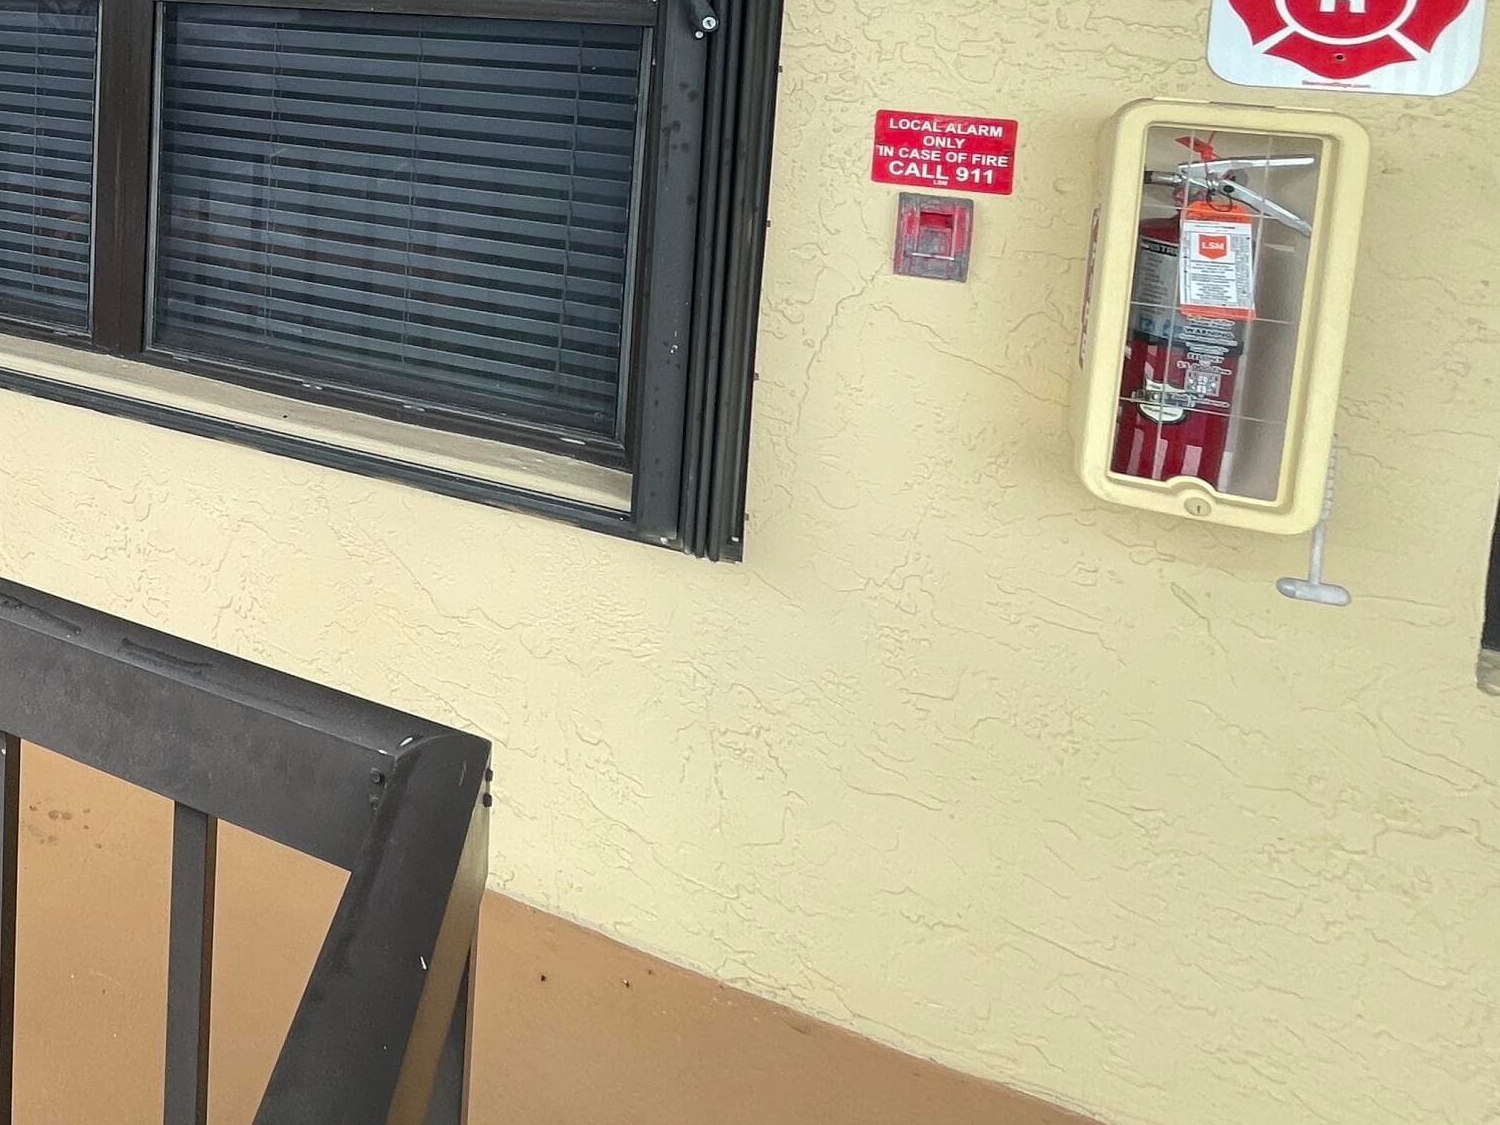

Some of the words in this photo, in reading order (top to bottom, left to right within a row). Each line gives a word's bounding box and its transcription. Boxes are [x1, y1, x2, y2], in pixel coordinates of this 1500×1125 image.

[889, 118, 944, 133] LOCAL
[944, 123, 1003, 138] ALARM
[923, 136, 966, 149] ONLY
[877, 145, 894, 157] IN
[898, 147, 941, 161] CASE
[945, 151, 967, 165] OF
[971, 154, 1010, 168] FIRE
[888, 161, 949, 181] CALL
[955, 167, 994, 185] 911
[1202, 241, 1225, 250] LSM
[1186, 328, 1233, 340] WARNING
